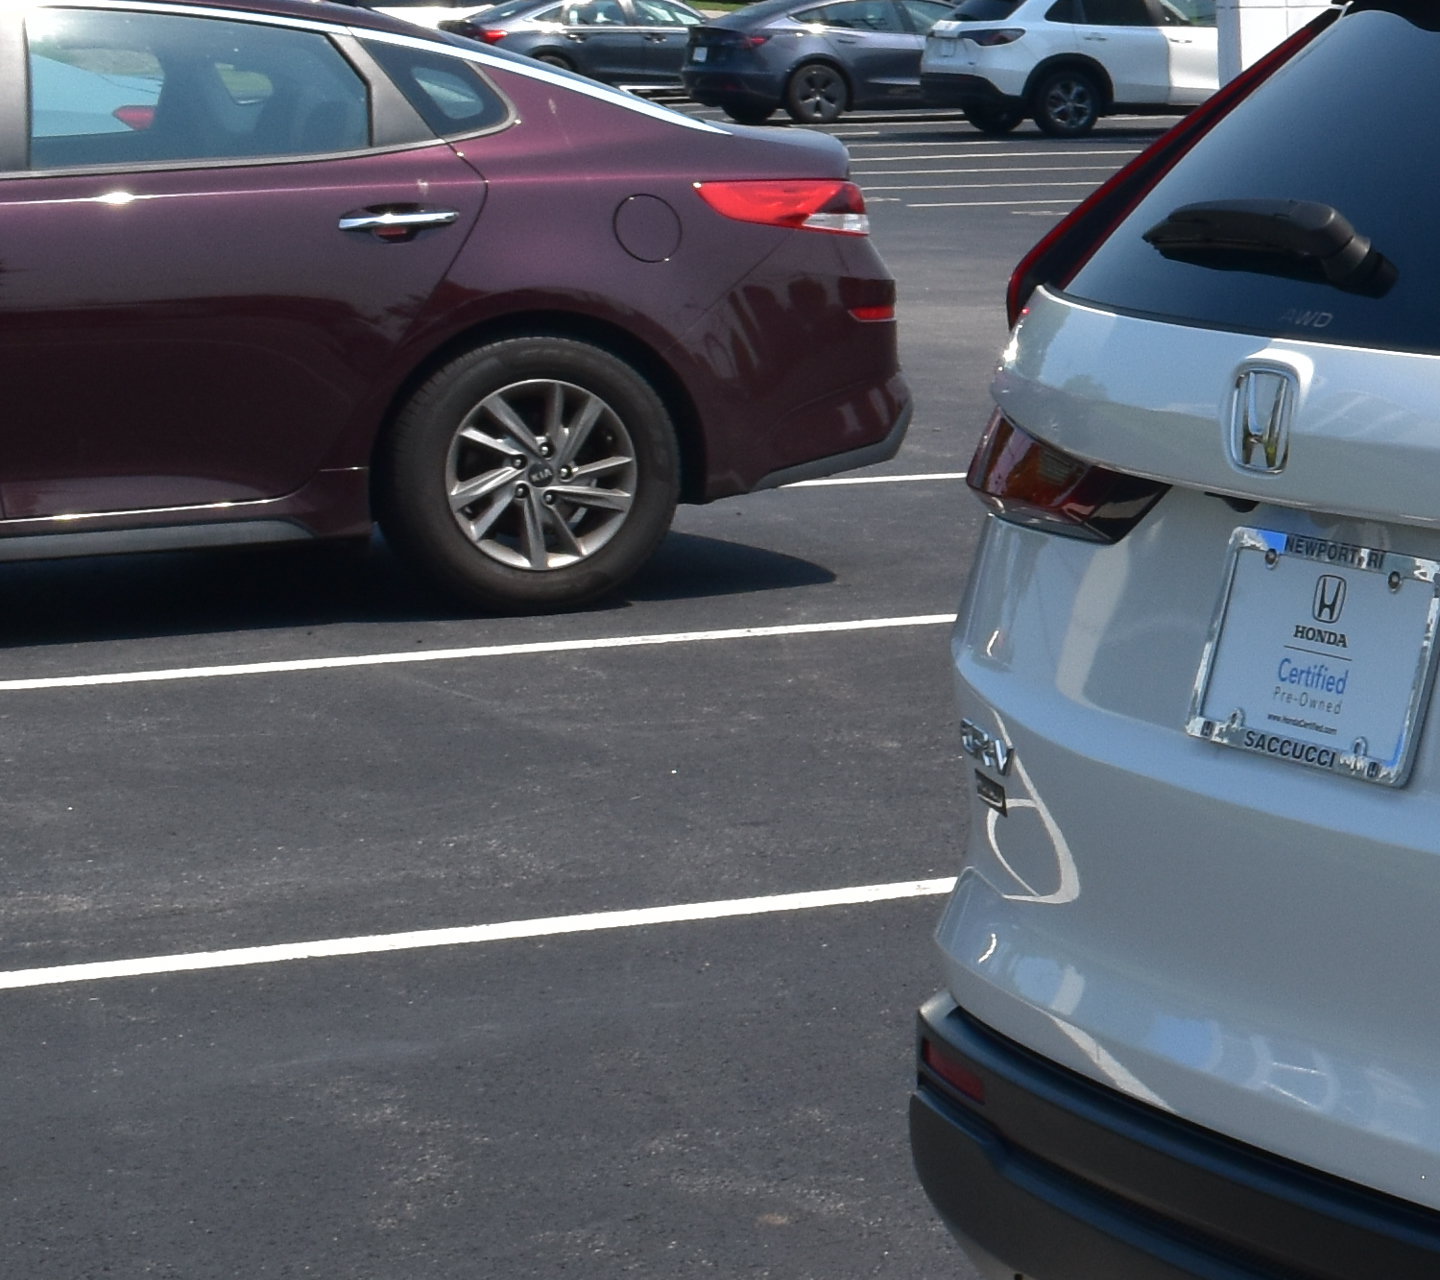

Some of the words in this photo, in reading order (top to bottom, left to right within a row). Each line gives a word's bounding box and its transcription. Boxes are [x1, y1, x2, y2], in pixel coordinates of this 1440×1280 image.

[531, 468, 553, 482] KIA
[1367, 550, 1385, 568] RI
[1293, 624, 1348, 648] HONDA
[1278, 657, 1349, 695] Certified
[1272, 685, 1343, 715] Pre-Owned
[1244, 730, 1336, 768] SACCUCCI
